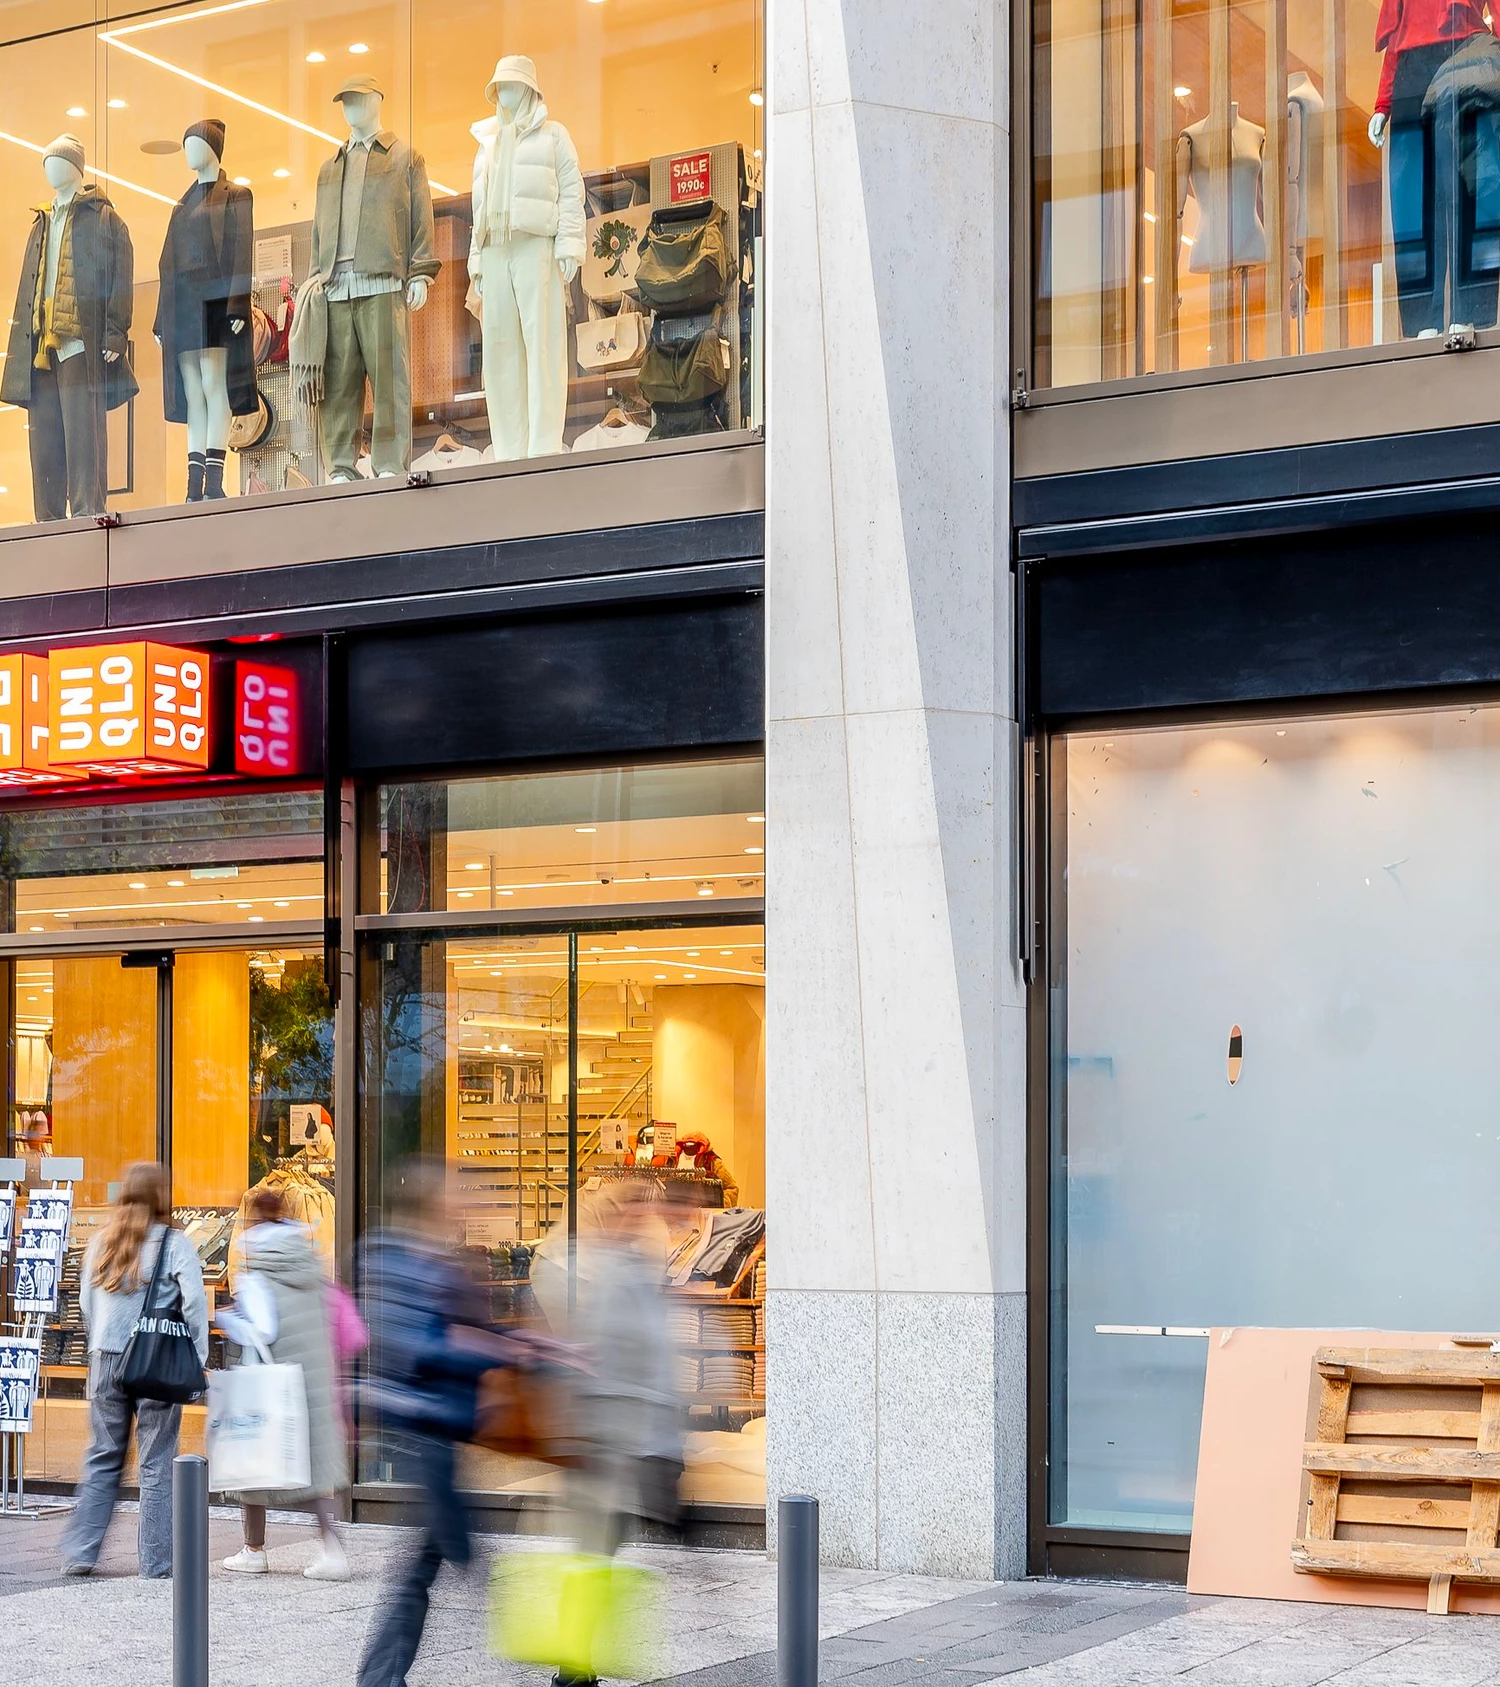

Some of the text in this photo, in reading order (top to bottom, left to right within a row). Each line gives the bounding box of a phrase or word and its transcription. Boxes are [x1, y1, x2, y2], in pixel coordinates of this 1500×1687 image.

[673, 159, 707, 178] SALE
[60, 667, 94, 751] UNI
[100, 656, 139, 748] QLO
[153, 662, 177, 748] UNI
[179, 661, 205, 752] QLO
[171, 1210, 218, 1220] NIQLO
